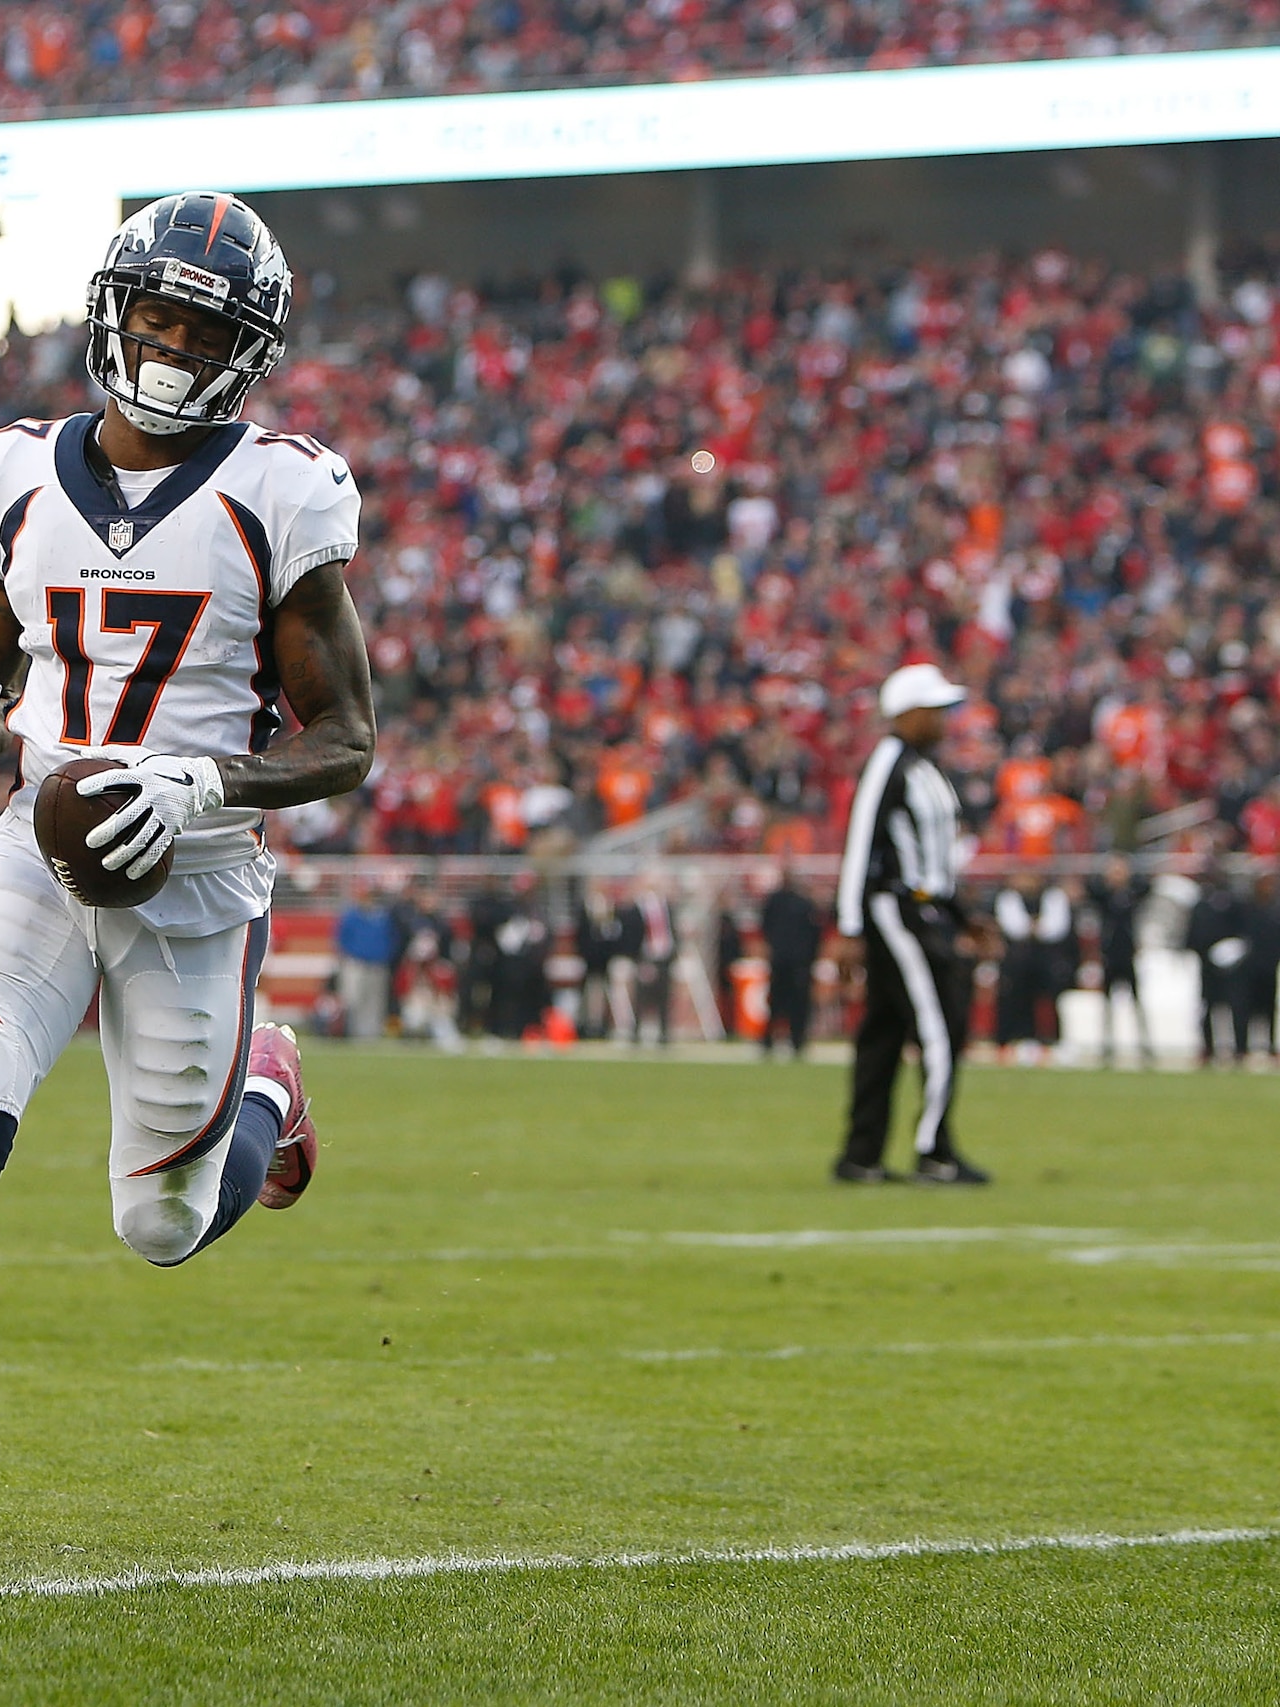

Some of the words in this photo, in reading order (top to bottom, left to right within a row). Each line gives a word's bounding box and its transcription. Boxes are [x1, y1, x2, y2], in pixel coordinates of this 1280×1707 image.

[180, 267, 216, 288] BRONCOS
[112, 533, 129, 546] NFL
[80, 569, 156, 580] BRONCOS
[45, 586, 213, 746] 17
